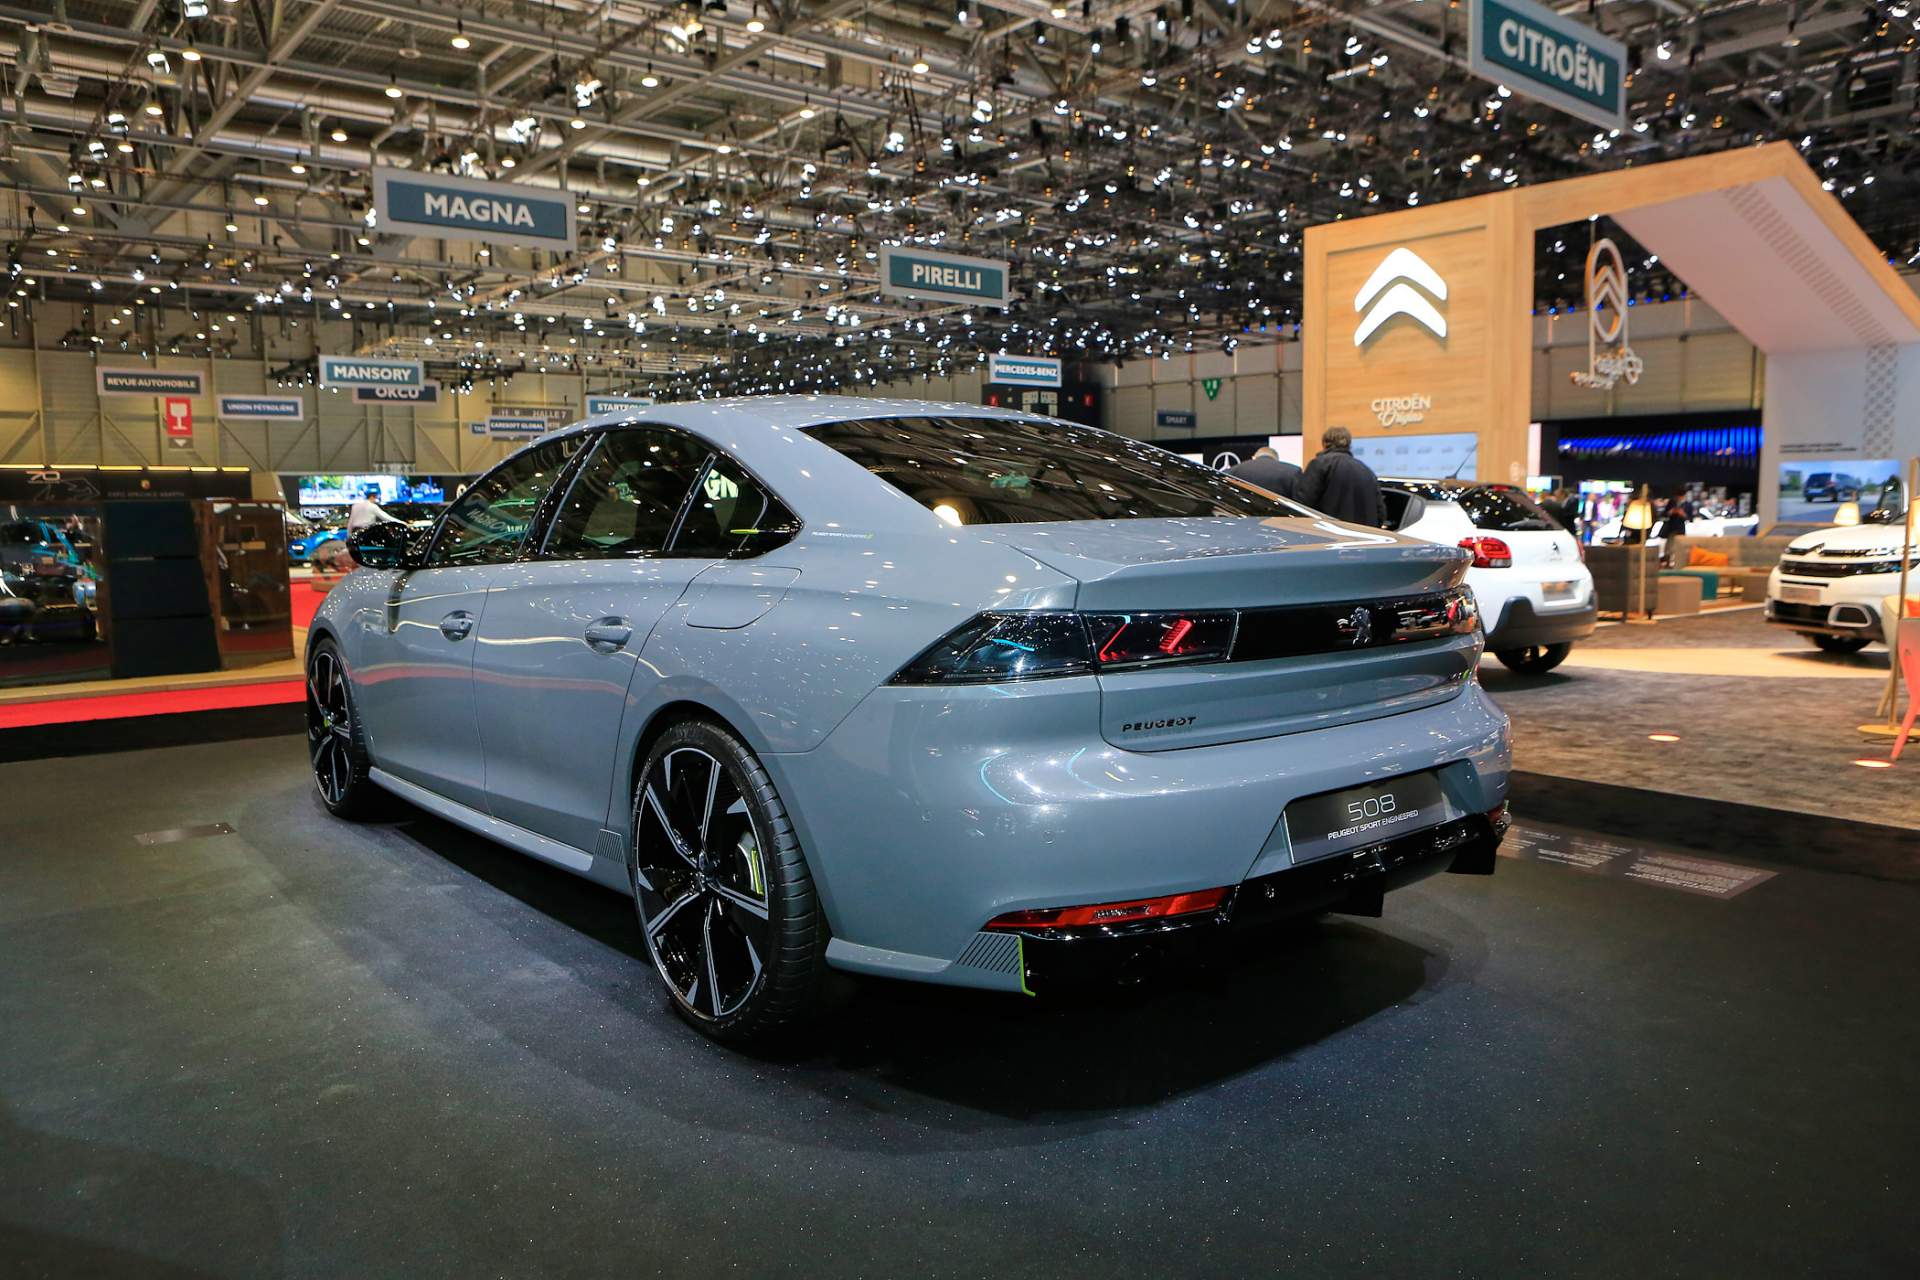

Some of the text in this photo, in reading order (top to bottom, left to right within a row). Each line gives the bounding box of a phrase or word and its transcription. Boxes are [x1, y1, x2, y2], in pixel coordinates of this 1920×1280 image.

[1500, 19, 1605, 96] CITROËN
[424, 192, 535, 228] MAGNA
[912, 263, 982, 290] PIRELLI
[334, 365, 411, 381] MANSORY
[994, 364, 1057, 377] MERCEDES-BENZ
[107, 378, 196, 388] REVUE AUTOMOBILE
[1371, 394, 1432, 413] CITROËN
[1122, 716, 1197, 733] PEUGEOT
[1347, 793, 1396, 822] 508
[1327, 809, 1419, 840] PEUGEOT SPORT ENGINEERED
